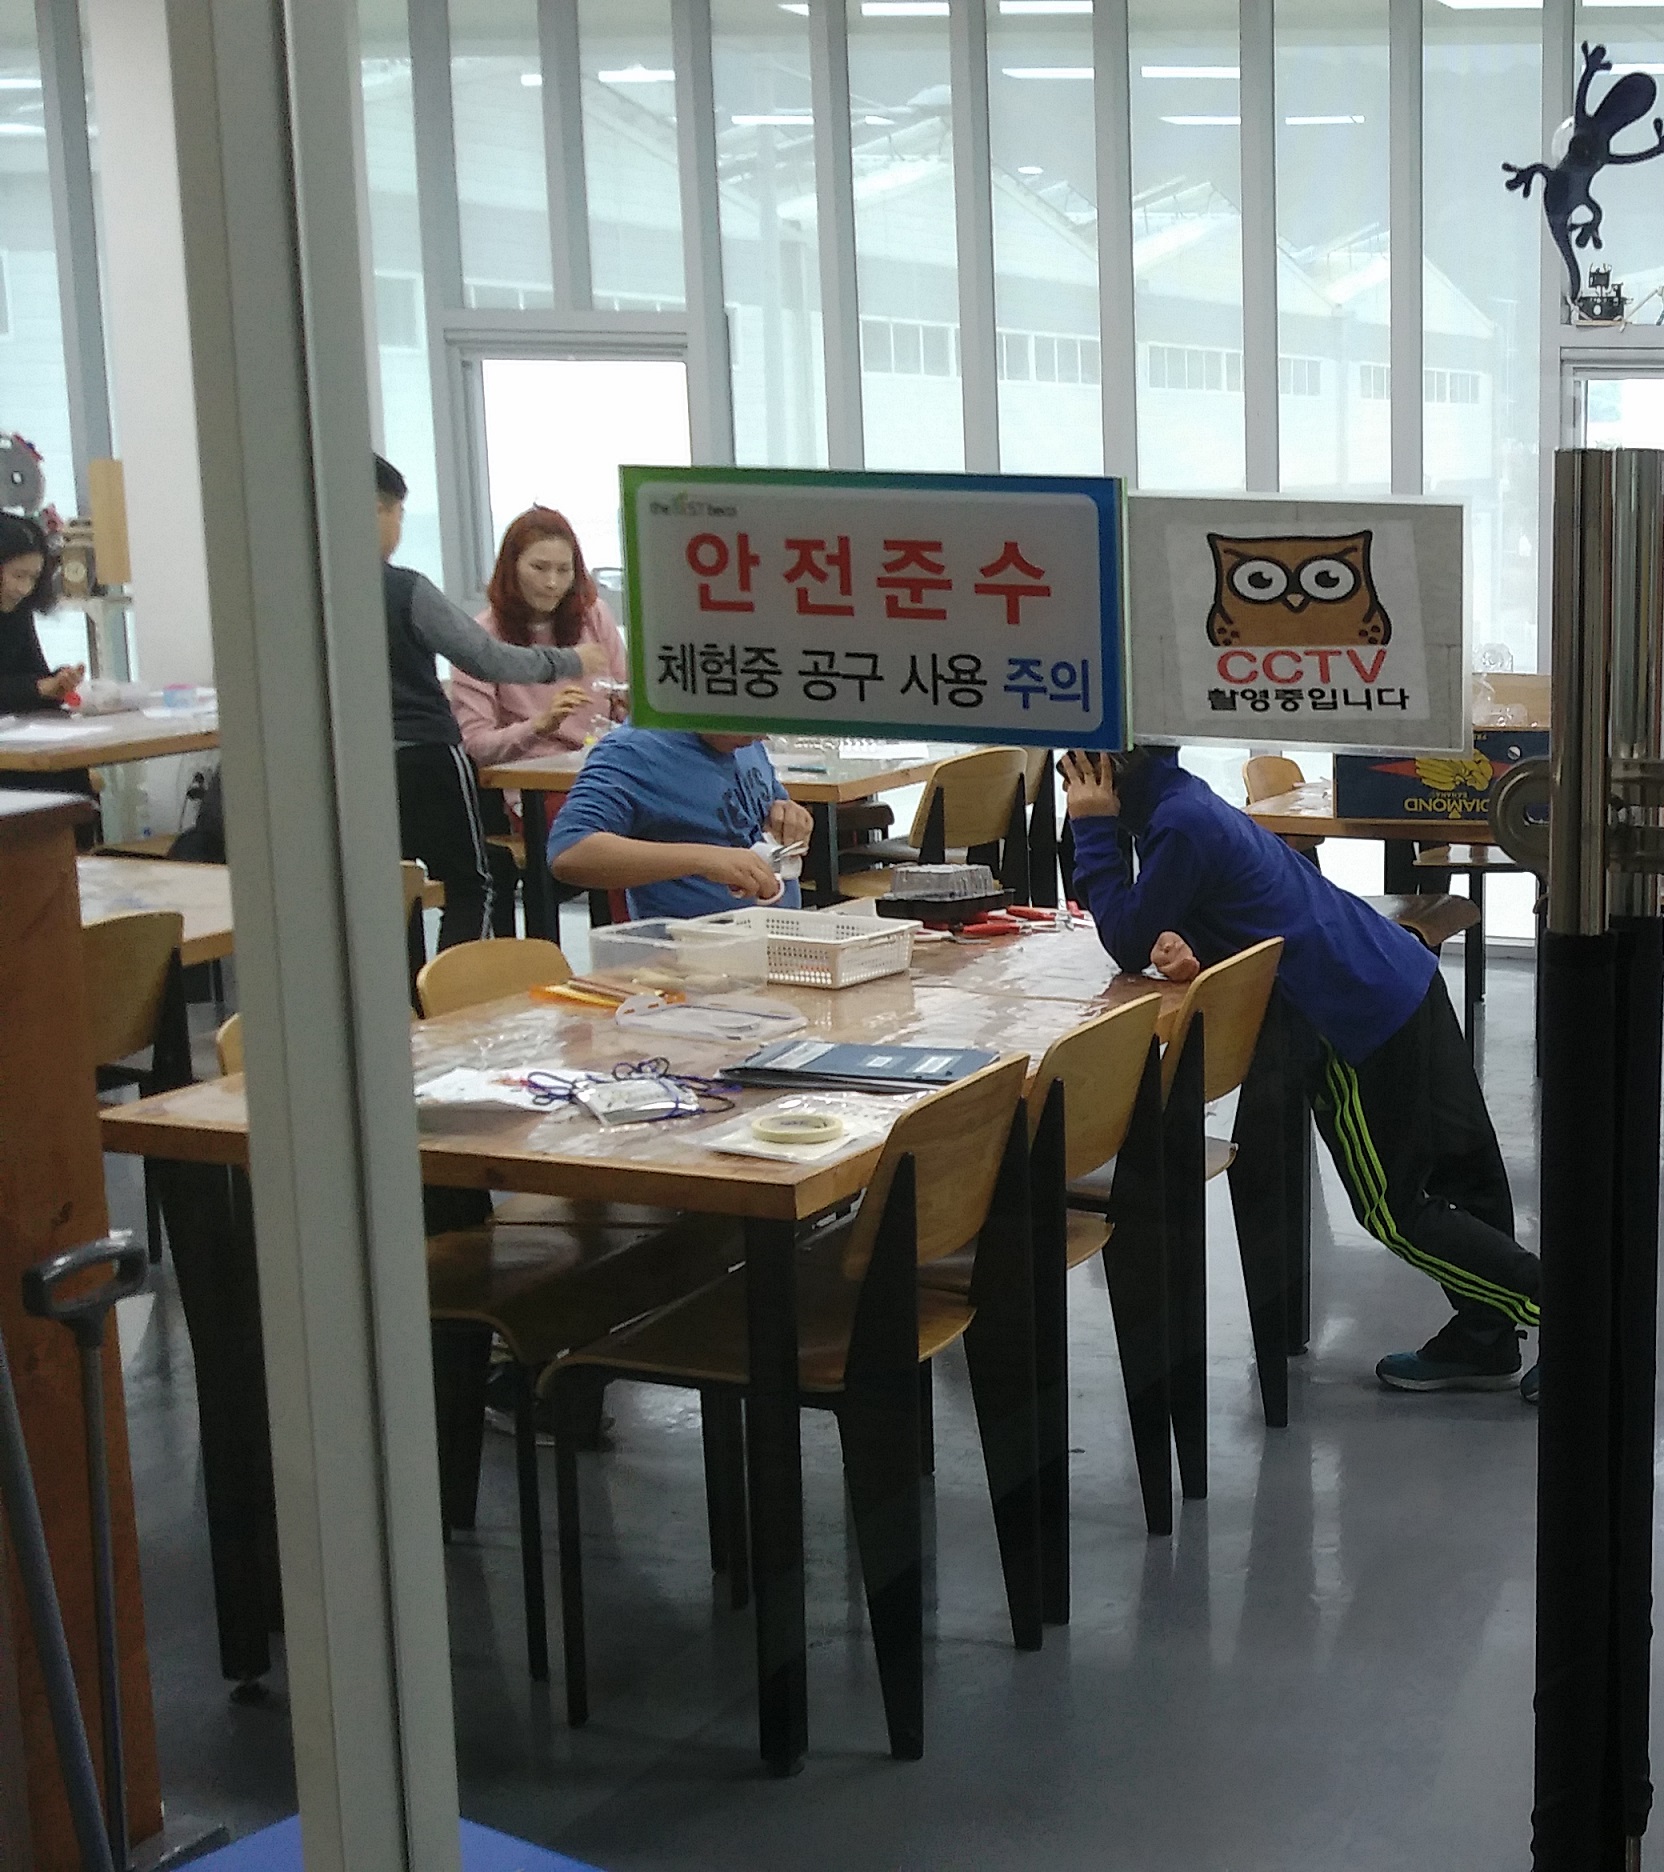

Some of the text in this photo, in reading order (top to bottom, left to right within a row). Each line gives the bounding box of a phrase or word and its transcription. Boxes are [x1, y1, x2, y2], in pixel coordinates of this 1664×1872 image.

[685, 532, 1052, 625] 안전준수
[658, 643, 1089, 712] 체험중 공구 사용 주의
[1217, 649, 1387, 685] CCTV
[1208, 687, 1410, 712] 촬영중입니다
